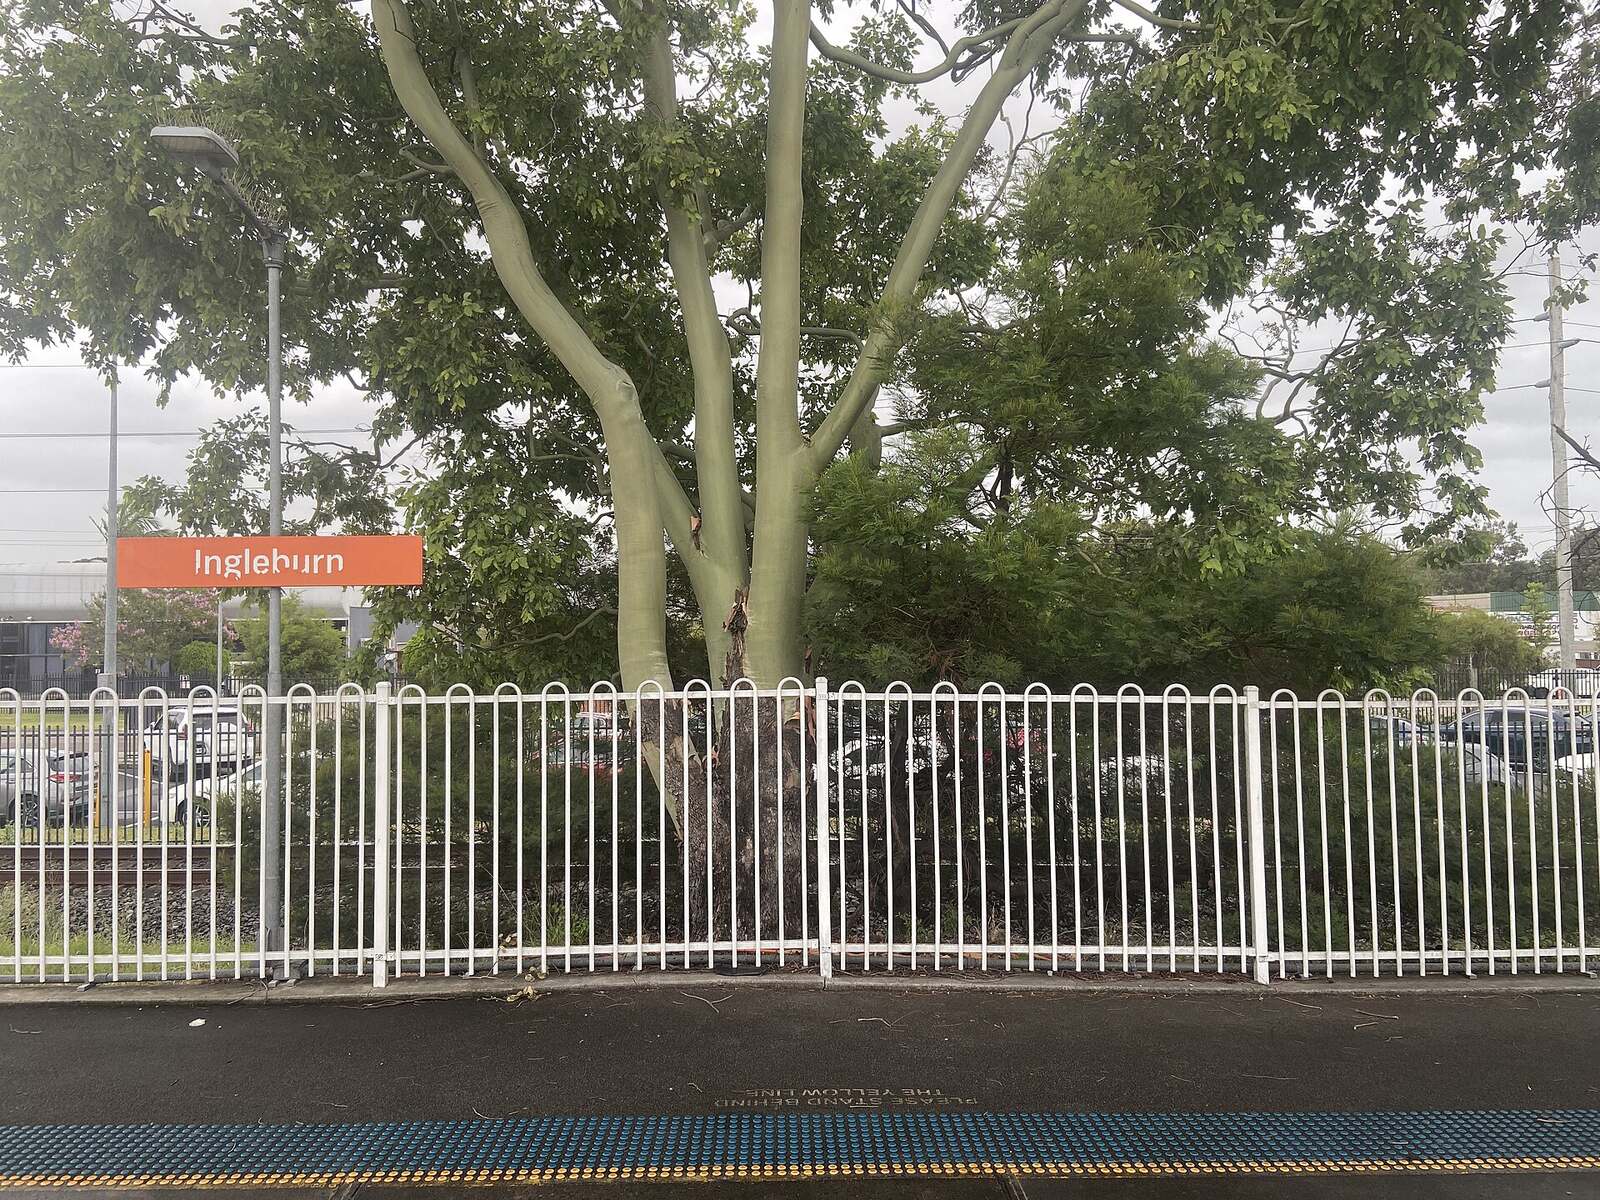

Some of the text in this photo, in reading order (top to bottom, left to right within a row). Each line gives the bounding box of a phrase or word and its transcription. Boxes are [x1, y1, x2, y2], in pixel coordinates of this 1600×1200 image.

[195, 548, 344, 580] Ingleburn
[744, 1088, 945, 1097] THE YELLOW LINE
[713, 1097, 979, 1107] PLEASE STAND BEHIND
